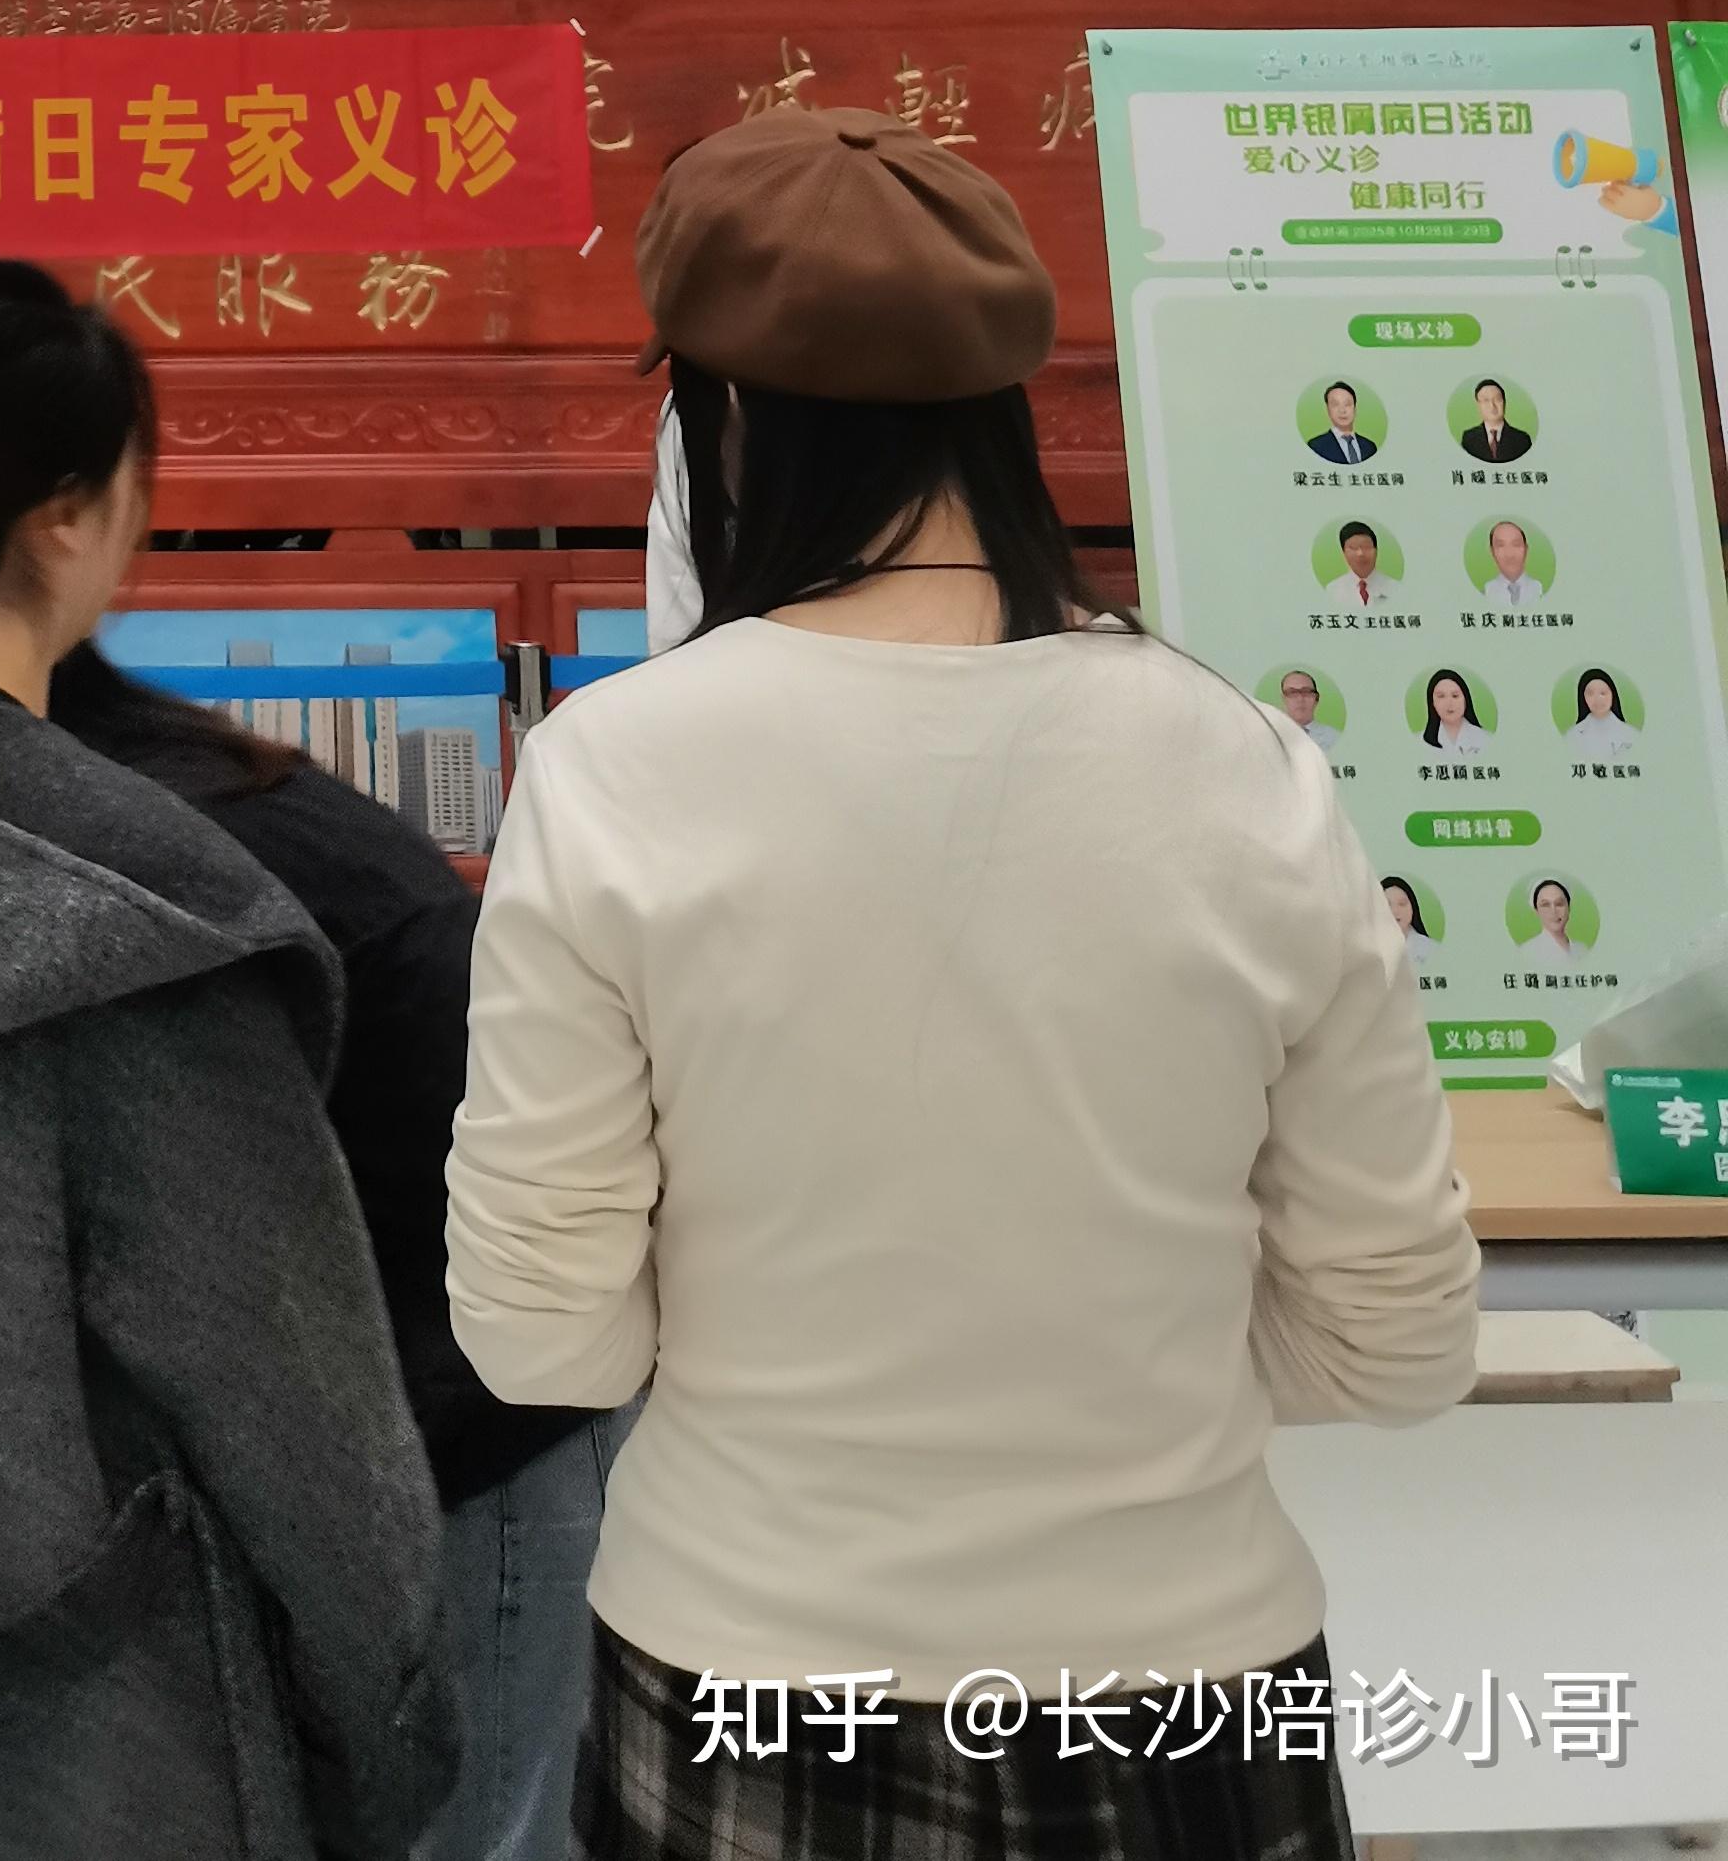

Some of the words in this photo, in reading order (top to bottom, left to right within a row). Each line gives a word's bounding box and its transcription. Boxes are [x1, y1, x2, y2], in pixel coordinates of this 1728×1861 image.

[1223, 101, 1534, 138] 世界银屑病日活动
[1243, 144, 1381, 174] 爱心义诊
[1349, 180, 1487, 211] 健康同行
[1374, 320, 1454, 340] 现场义诊
[1292, 471, 1341, 487] 梁云生
[1349, 472, 1405, 486] 主任医师
[1492, 470, 1549, 485] 主任医师
[1307, 613, 1360, 629] 苏玉文
[1365, 615, 1422, 629] 主任医师
[1502, 613, 1573, 628] 副主任医师
[1473, 765, 1501, 781] 医师
[1613, 764, 1641, 779] 医师
[1444, 1028, 1528, 1051] 义诊安排
[1656, 1095, 1728, 1148] 李
